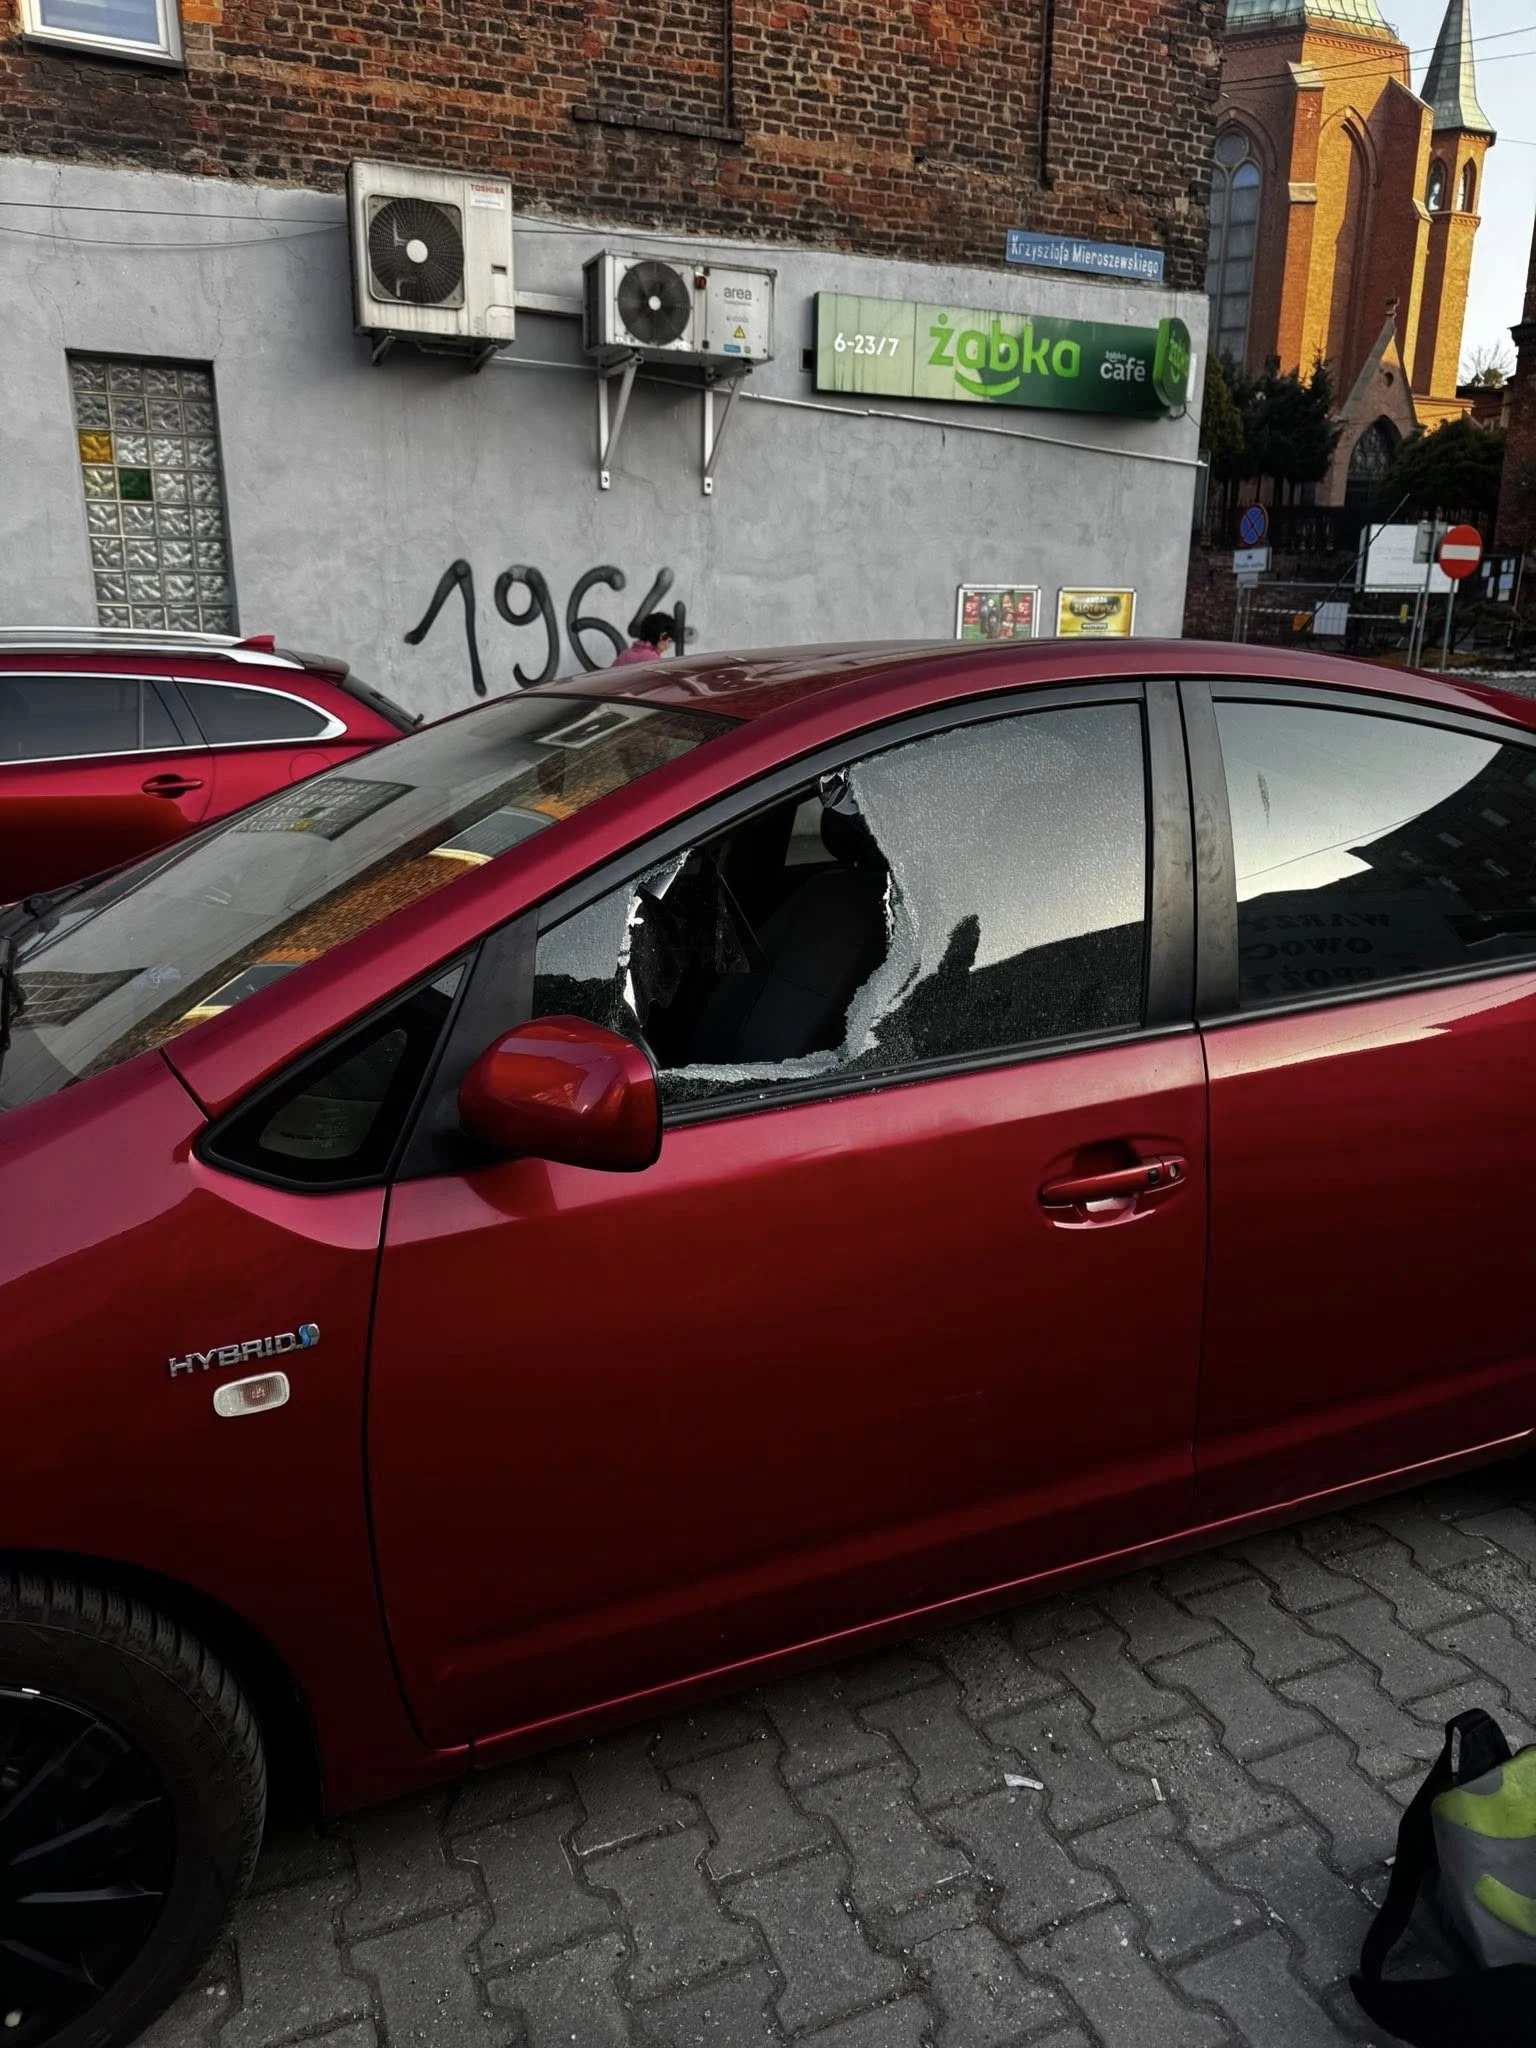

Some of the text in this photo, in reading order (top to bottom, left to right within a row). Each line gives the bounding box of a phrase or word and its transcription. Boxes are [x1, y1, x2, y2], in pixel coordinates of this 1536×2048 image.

[470, 183, 505, 195] TOSHIBA
[1010, 234, 1160, 278] Krzysztofa Mieroszewskiego
[723, 287, 752, 301] area
[833, 332, 900, 358] 6-23/7
[404, 557, 698, 697] 1964
[167, 1332, 297, 1378] HYBRID
